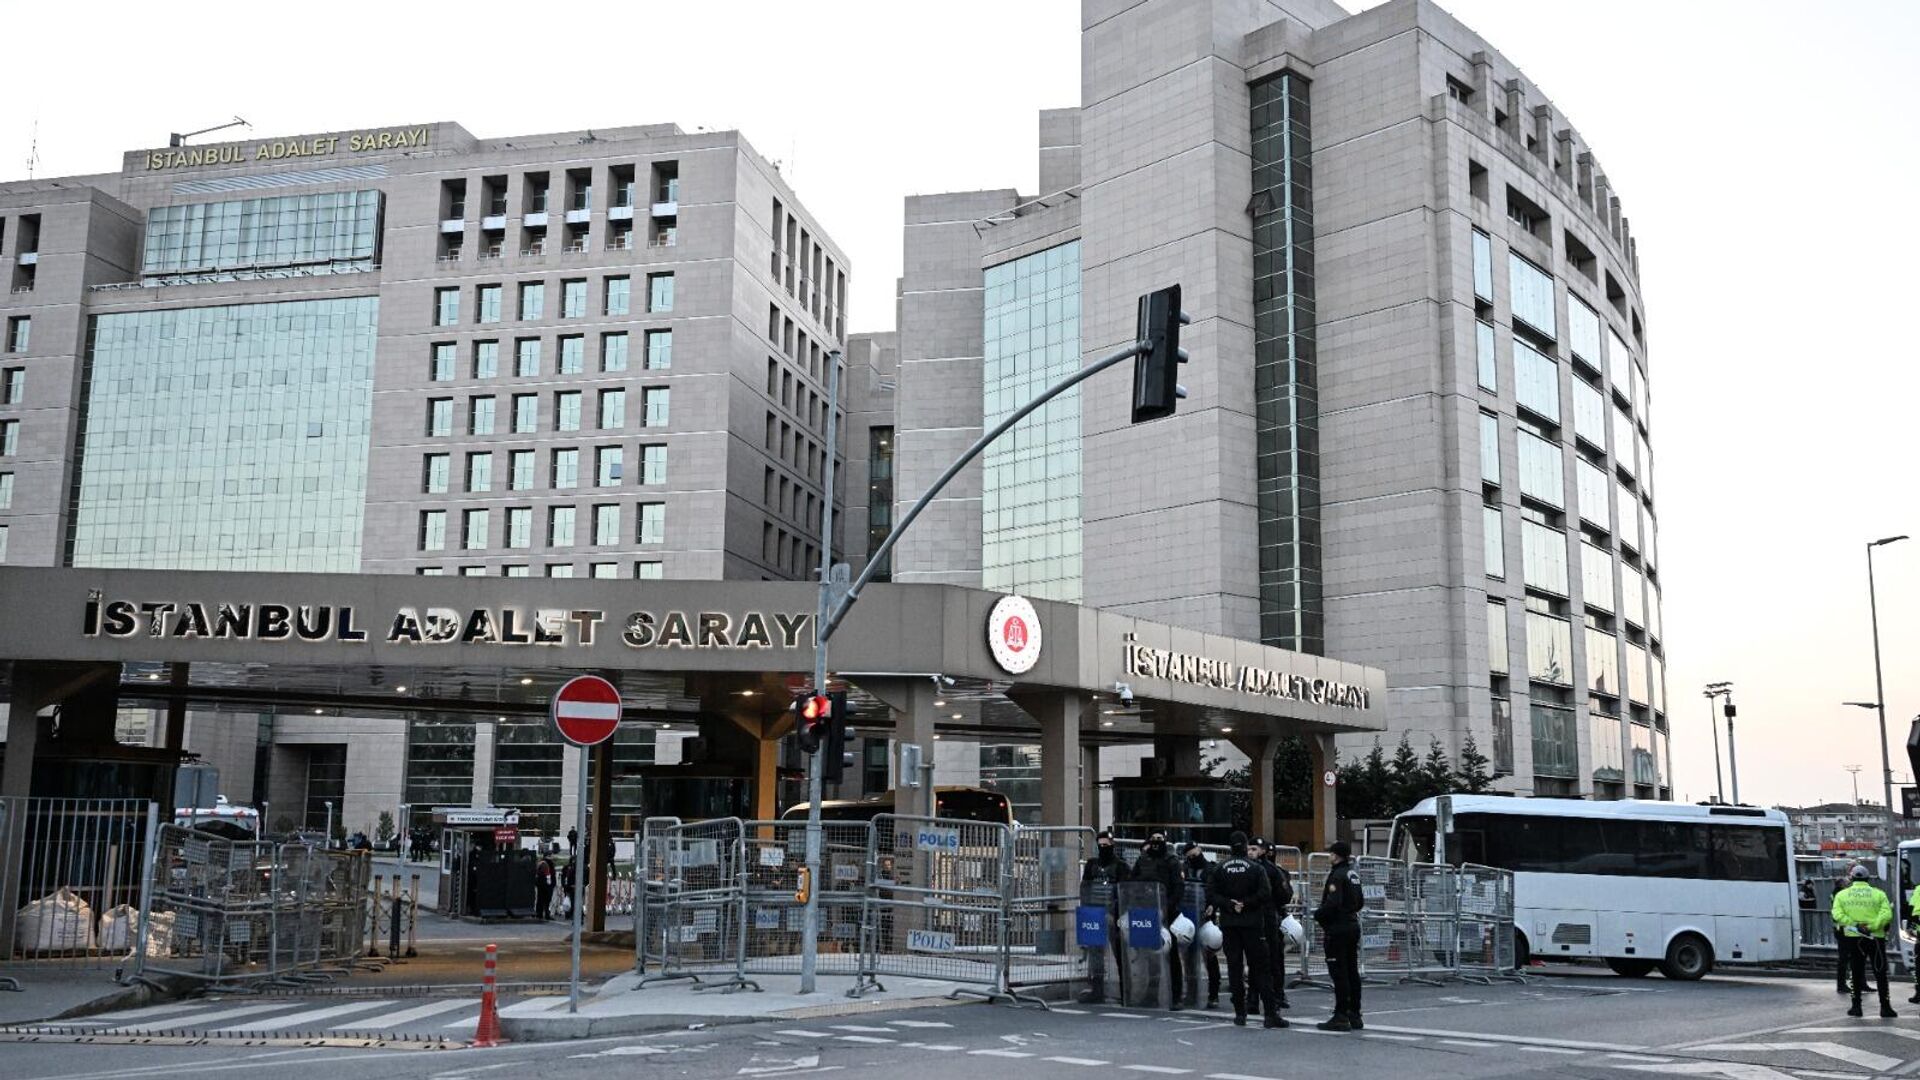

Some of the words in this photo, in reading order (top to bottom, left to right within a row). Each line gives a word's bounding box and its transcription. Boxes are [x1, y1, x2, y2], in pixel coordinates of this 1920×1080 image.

[146, 146, 246, 170] İSTANBUL
[256, 136, 339, 160] ADALET
[350, 129, 428, 151] SARAYI
[83, 588, 368, 641] İSTANBUL
[386, 606, 604, 645] ADALET
[1124, 632, 1237, 688] İSTANBUL
